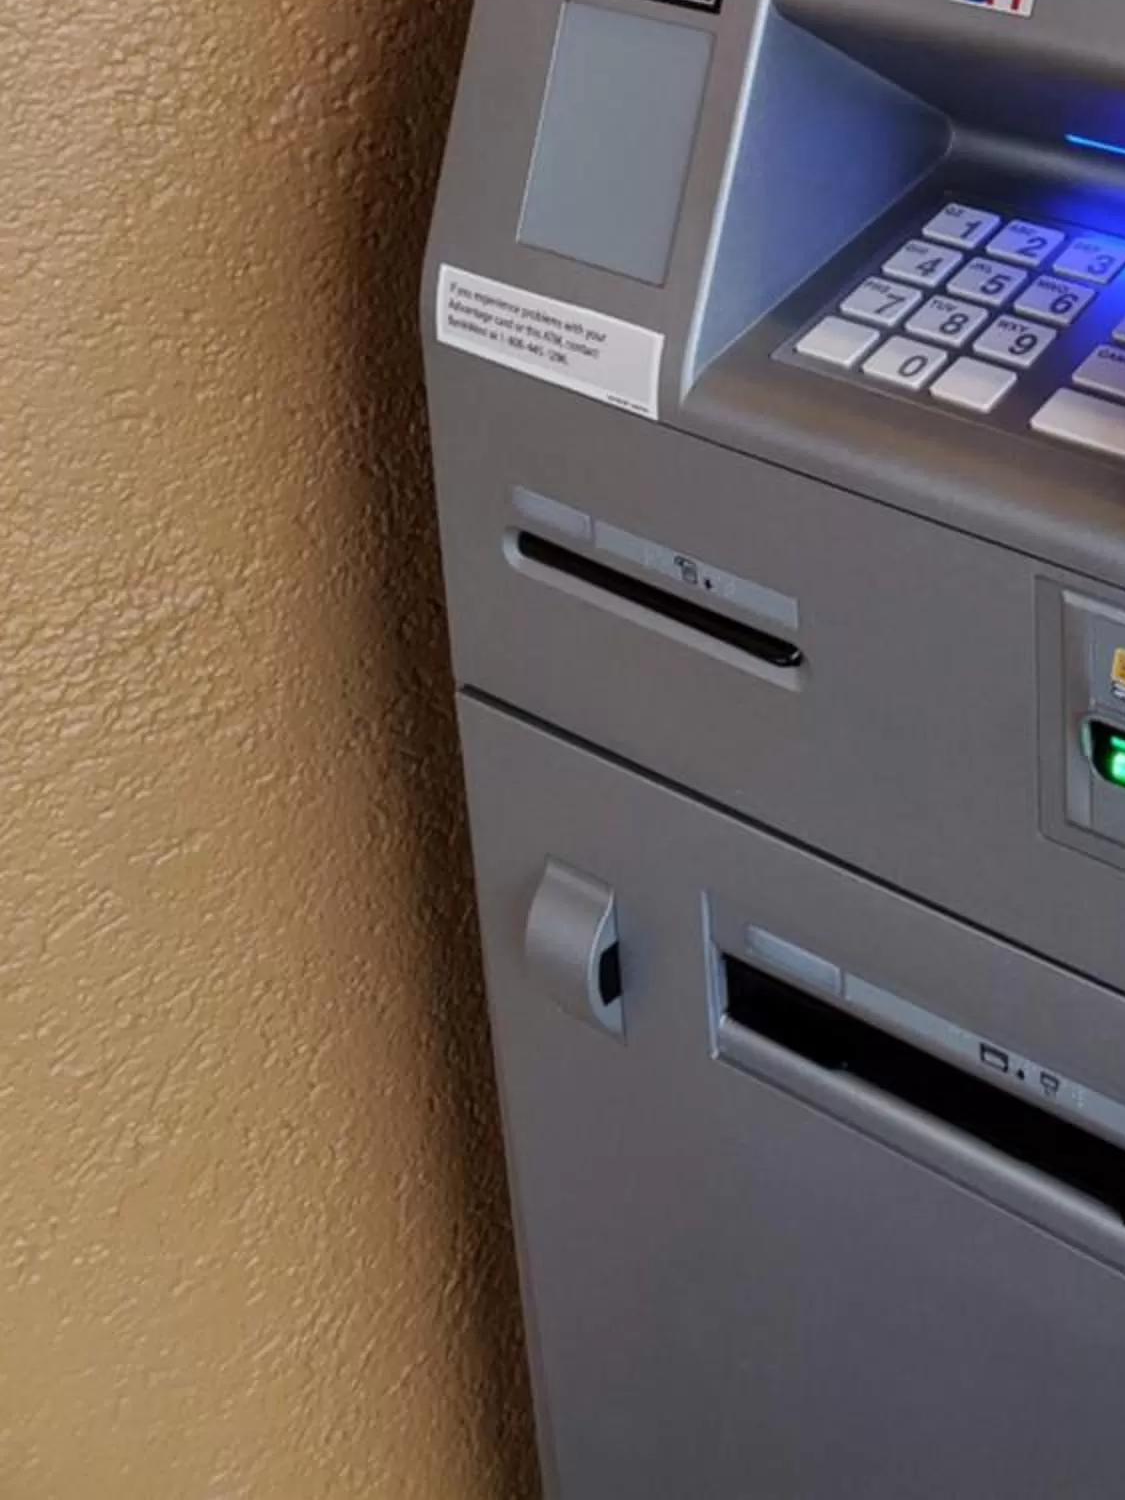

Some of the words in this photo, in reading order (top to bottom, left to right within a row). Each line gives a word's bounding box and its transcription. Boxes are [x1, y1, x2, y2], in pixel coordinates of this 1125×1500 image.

[959, 219, 984, 239] 1
[1016, 235, 1048, 258] 2
[915, 257, 944, 277] 4
[1087, 254, 1117, 275] 3
[980, 274, 1012, 295] 5
[873, 293, 906, 315] 7
[1050, 293, 1080, 315] 6
[940, 312, 969, 335] 8
[1007, 333, 1038, 356] 9
[897, 354, 929, 378] 0
